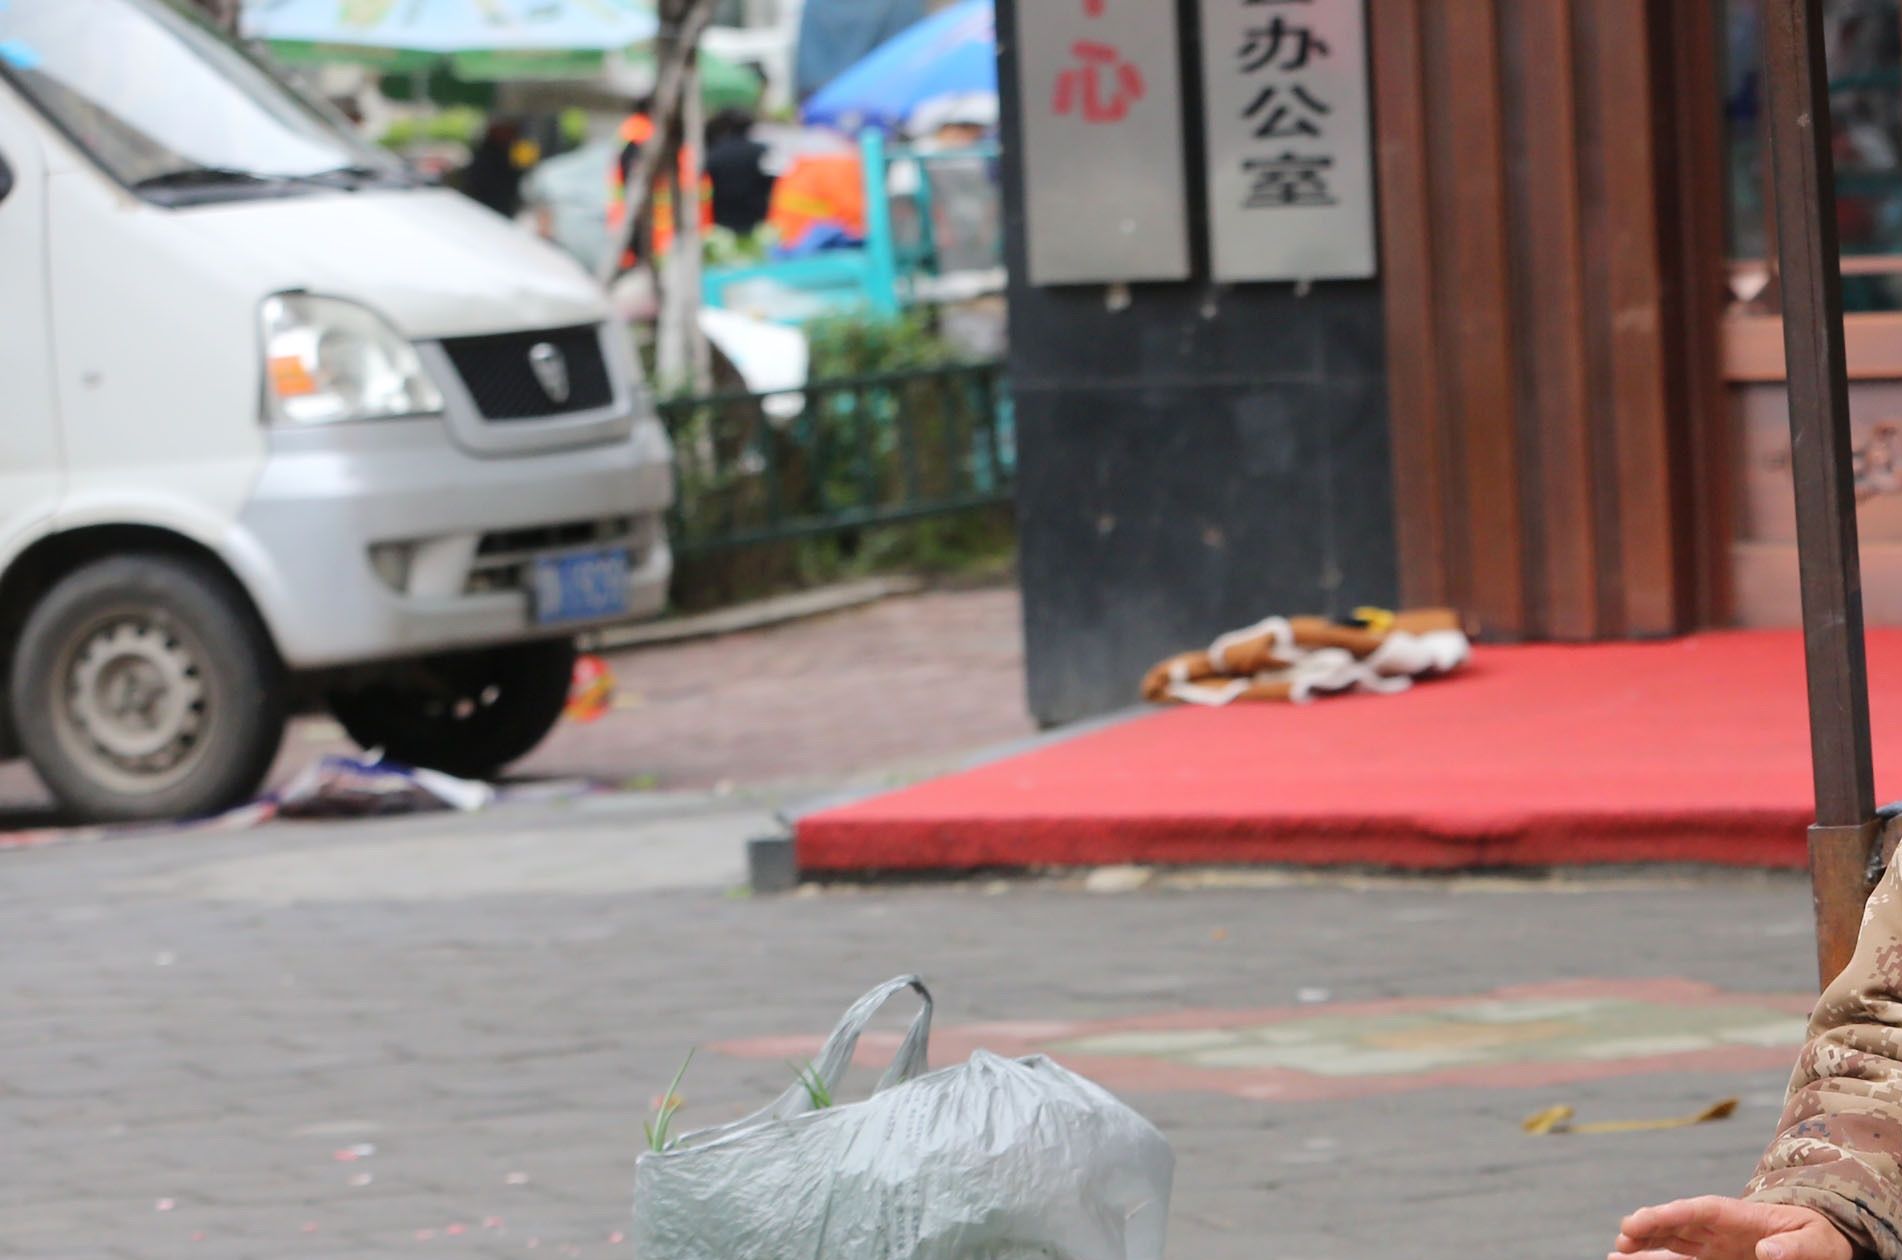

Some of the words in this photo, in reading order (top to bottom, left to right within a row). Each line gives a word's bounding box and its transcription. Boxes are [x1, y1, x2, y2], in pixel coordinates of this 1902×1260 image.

[1052, 0, 1147, 124] 心
[1237, 0, 1341, 209] 办公室
